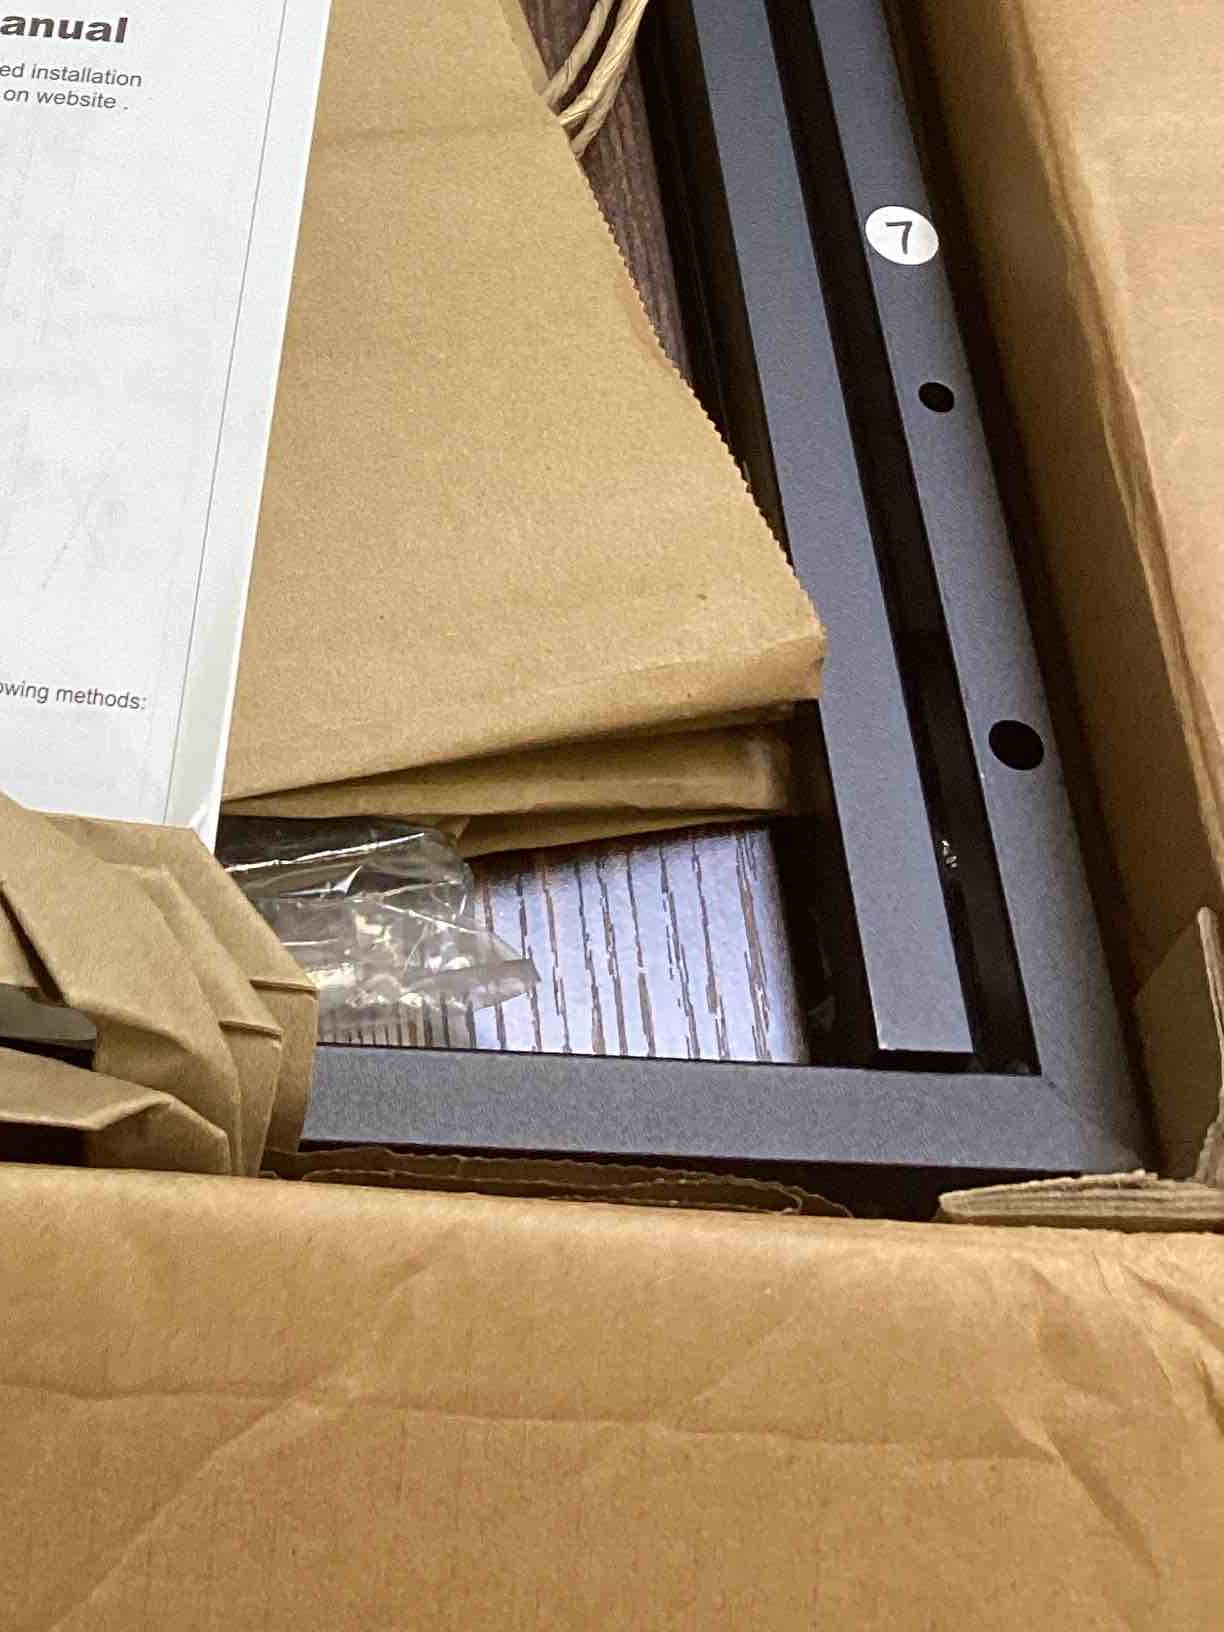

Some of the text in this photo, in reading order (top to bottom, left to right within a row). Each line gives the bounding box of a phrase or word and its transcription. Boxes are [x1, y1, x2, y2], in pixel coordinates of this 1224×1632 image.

[31, 63, 142, 88] installation
[3, 89, 29, 103] on
[36, 90, 117, 109] website
[884, 220, 913, 256] 7
[55, 688, 147, 711] methods:
